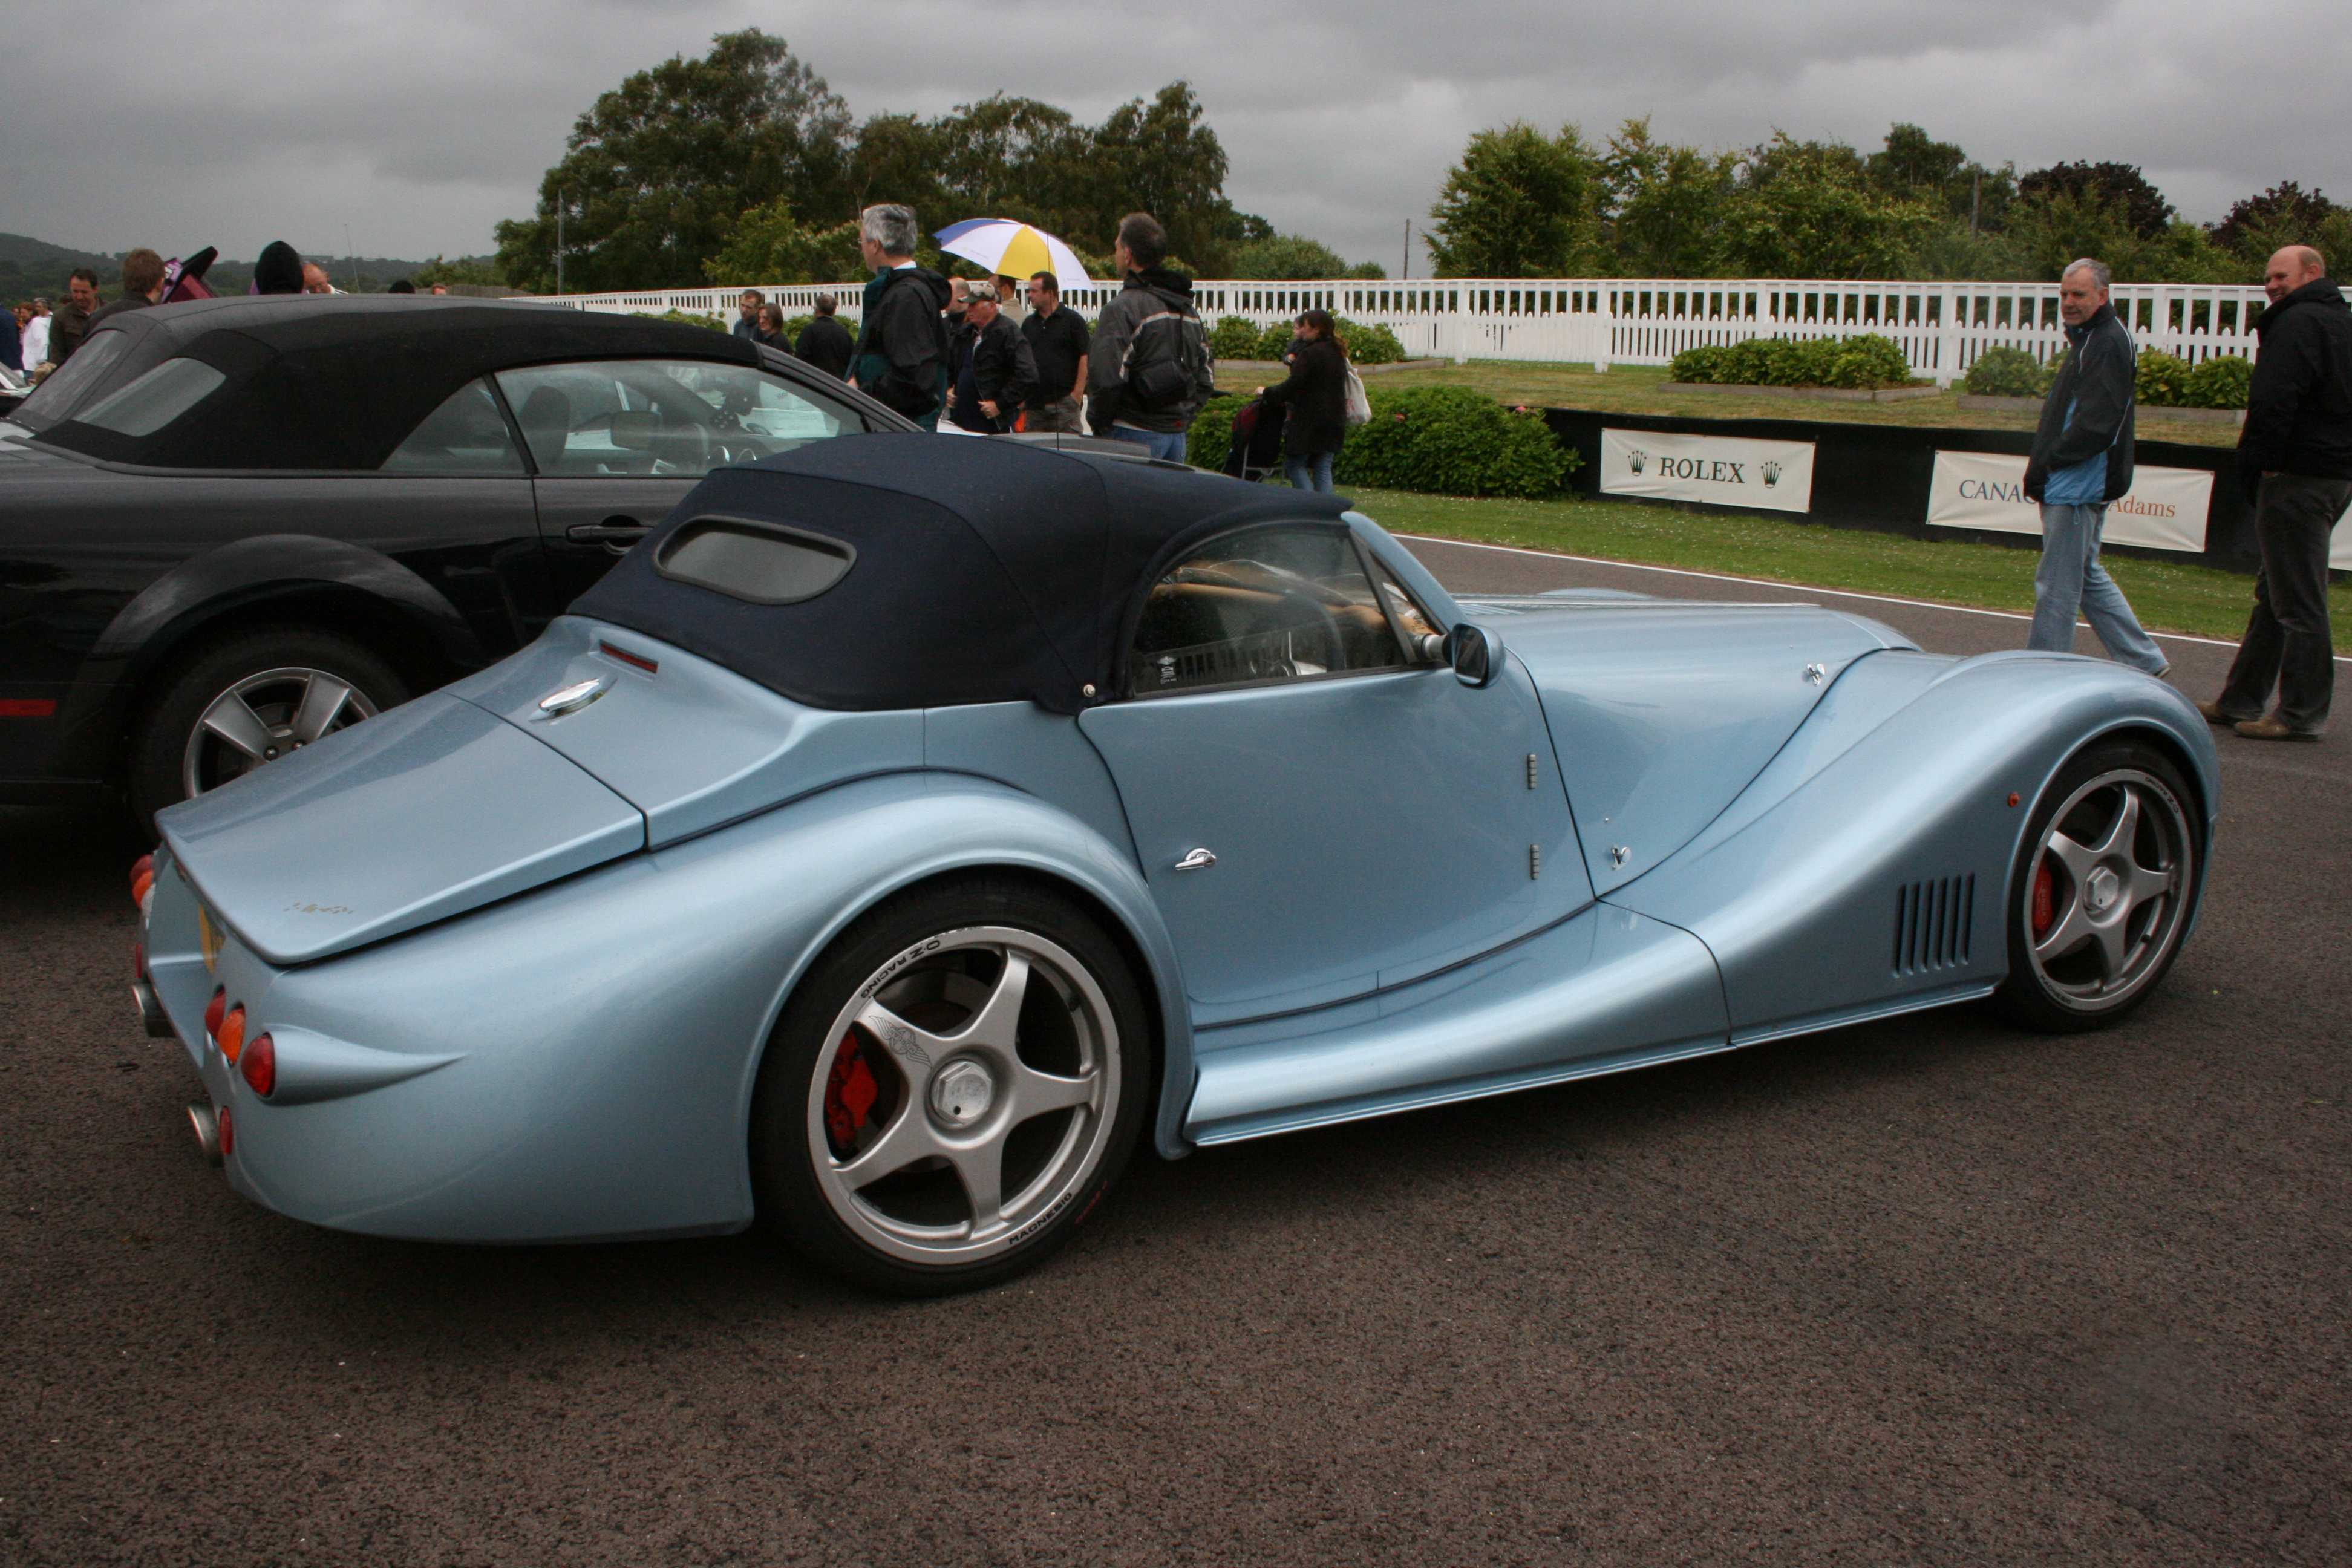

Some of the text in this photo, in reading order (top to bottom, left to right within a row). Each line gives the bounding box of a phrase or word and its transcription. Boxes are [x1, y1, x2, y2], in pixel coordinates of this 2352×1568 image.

[1658, 457, 1746, 484] ROLEX
[2107, 495, 2176, 517] Adams
[860, 956, 907, 999] RACING
[1008, 1192, 1072, 1244] MAGNESIO
